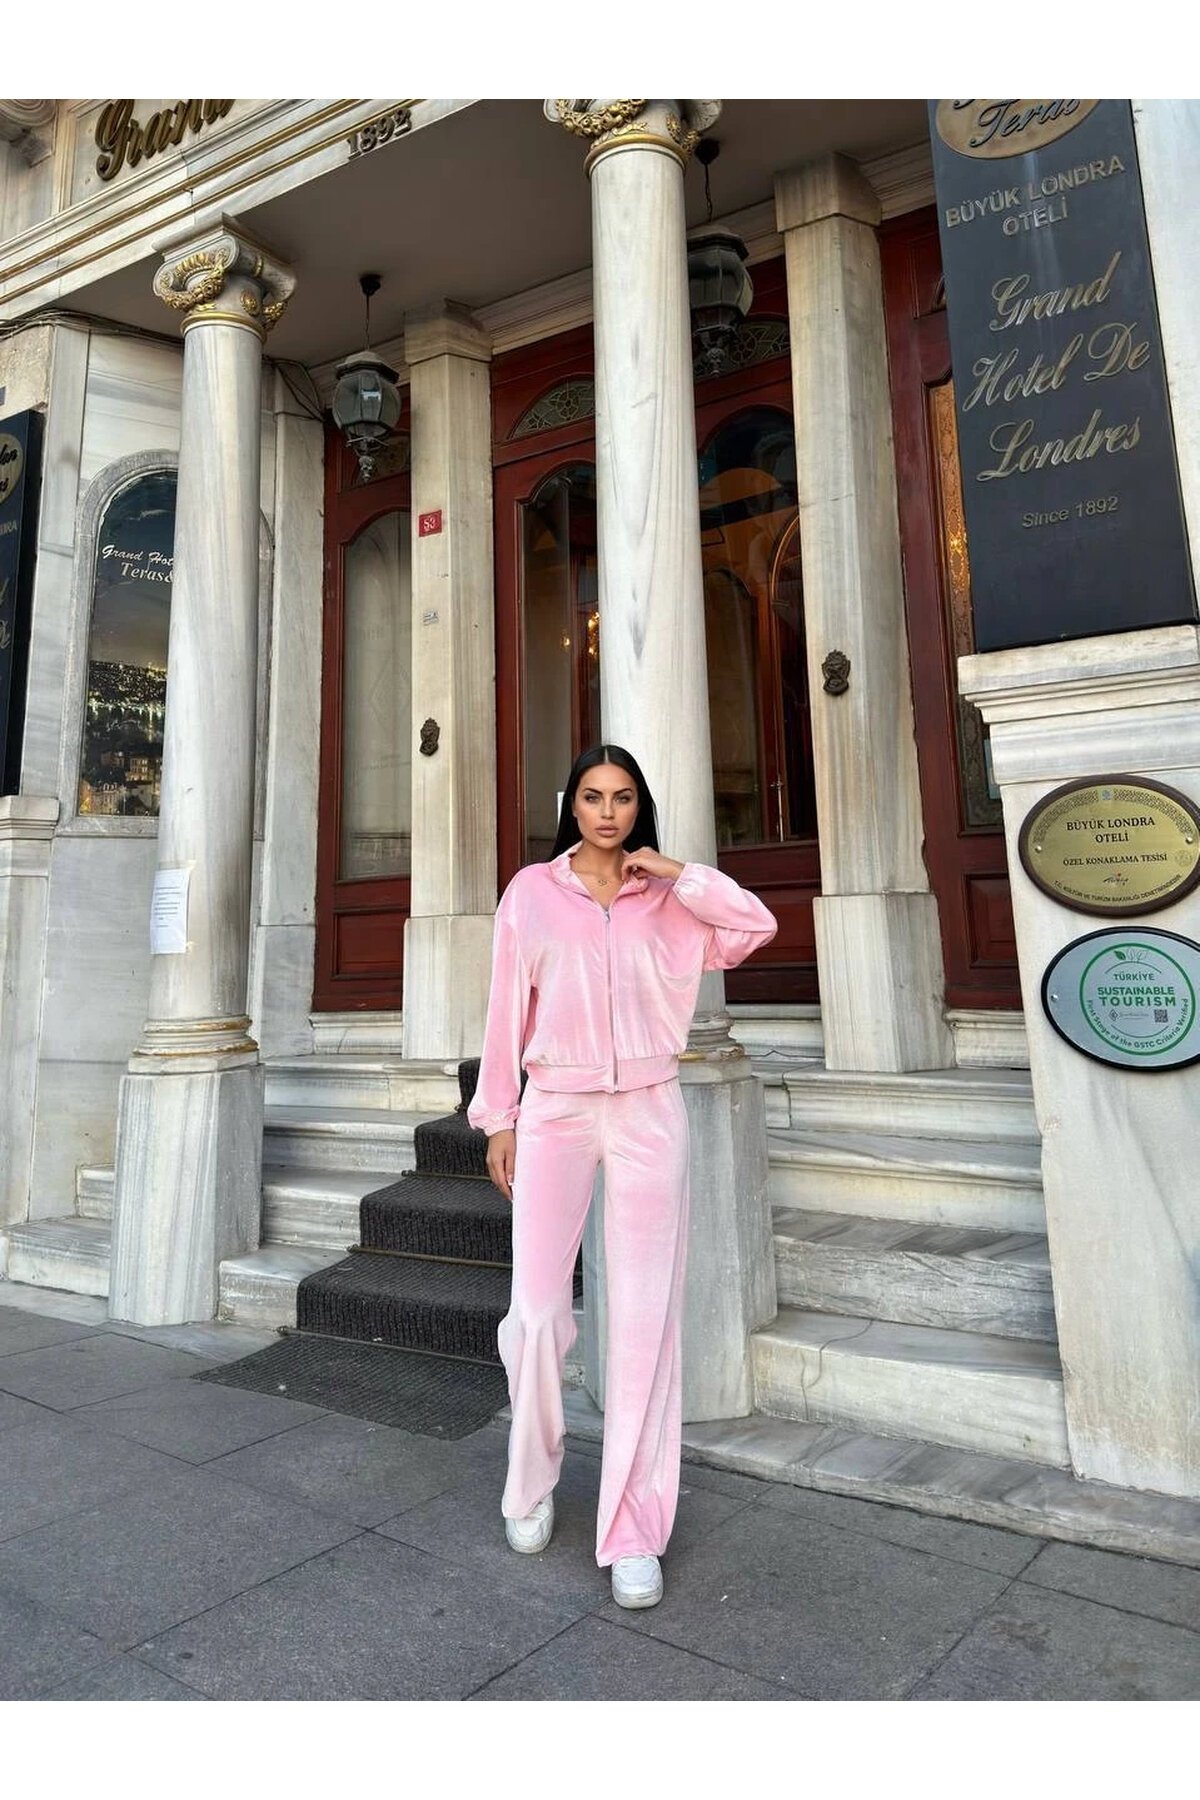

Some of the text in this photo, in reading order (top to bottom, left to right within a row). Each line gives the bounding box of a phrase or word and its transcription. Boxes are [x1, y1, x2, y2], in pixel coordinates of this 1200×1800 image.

[347, 107, 412, 160] 1892
[945, 154, 1126, 228] BÜYÜK LONDRA
[1002, 196, 1070, 236] OTELİ
[989, 250, 1122, 331] Grand
[961, 321, 1150, 412] Hotel De
[975, 408, 1141, 482] Londres
[1022, 496, 1119, 528] Since 1892
[102, 544, 174, 571] Grand Hot
[1066, 816, 1155, 831] BÜYÜK LONDRA
[1095, 830, 1129, 843] OTELİ
[1063, 857, 1085, 866] ÖZEL
[1086, 855, 1139, 865] KONAKLAMA
[1097, 986, 1175, 996] SUSTAINABLE
[1113, 971, 1155, 981] TÜRKİYE
[1098, 996, 1176, 1007] TOURISM
[1094, 1016, 1110, 1035] Stage
[1120, 1037, 1132, 1047] the
[1134, 1040, 1155, 1049] GSTC
